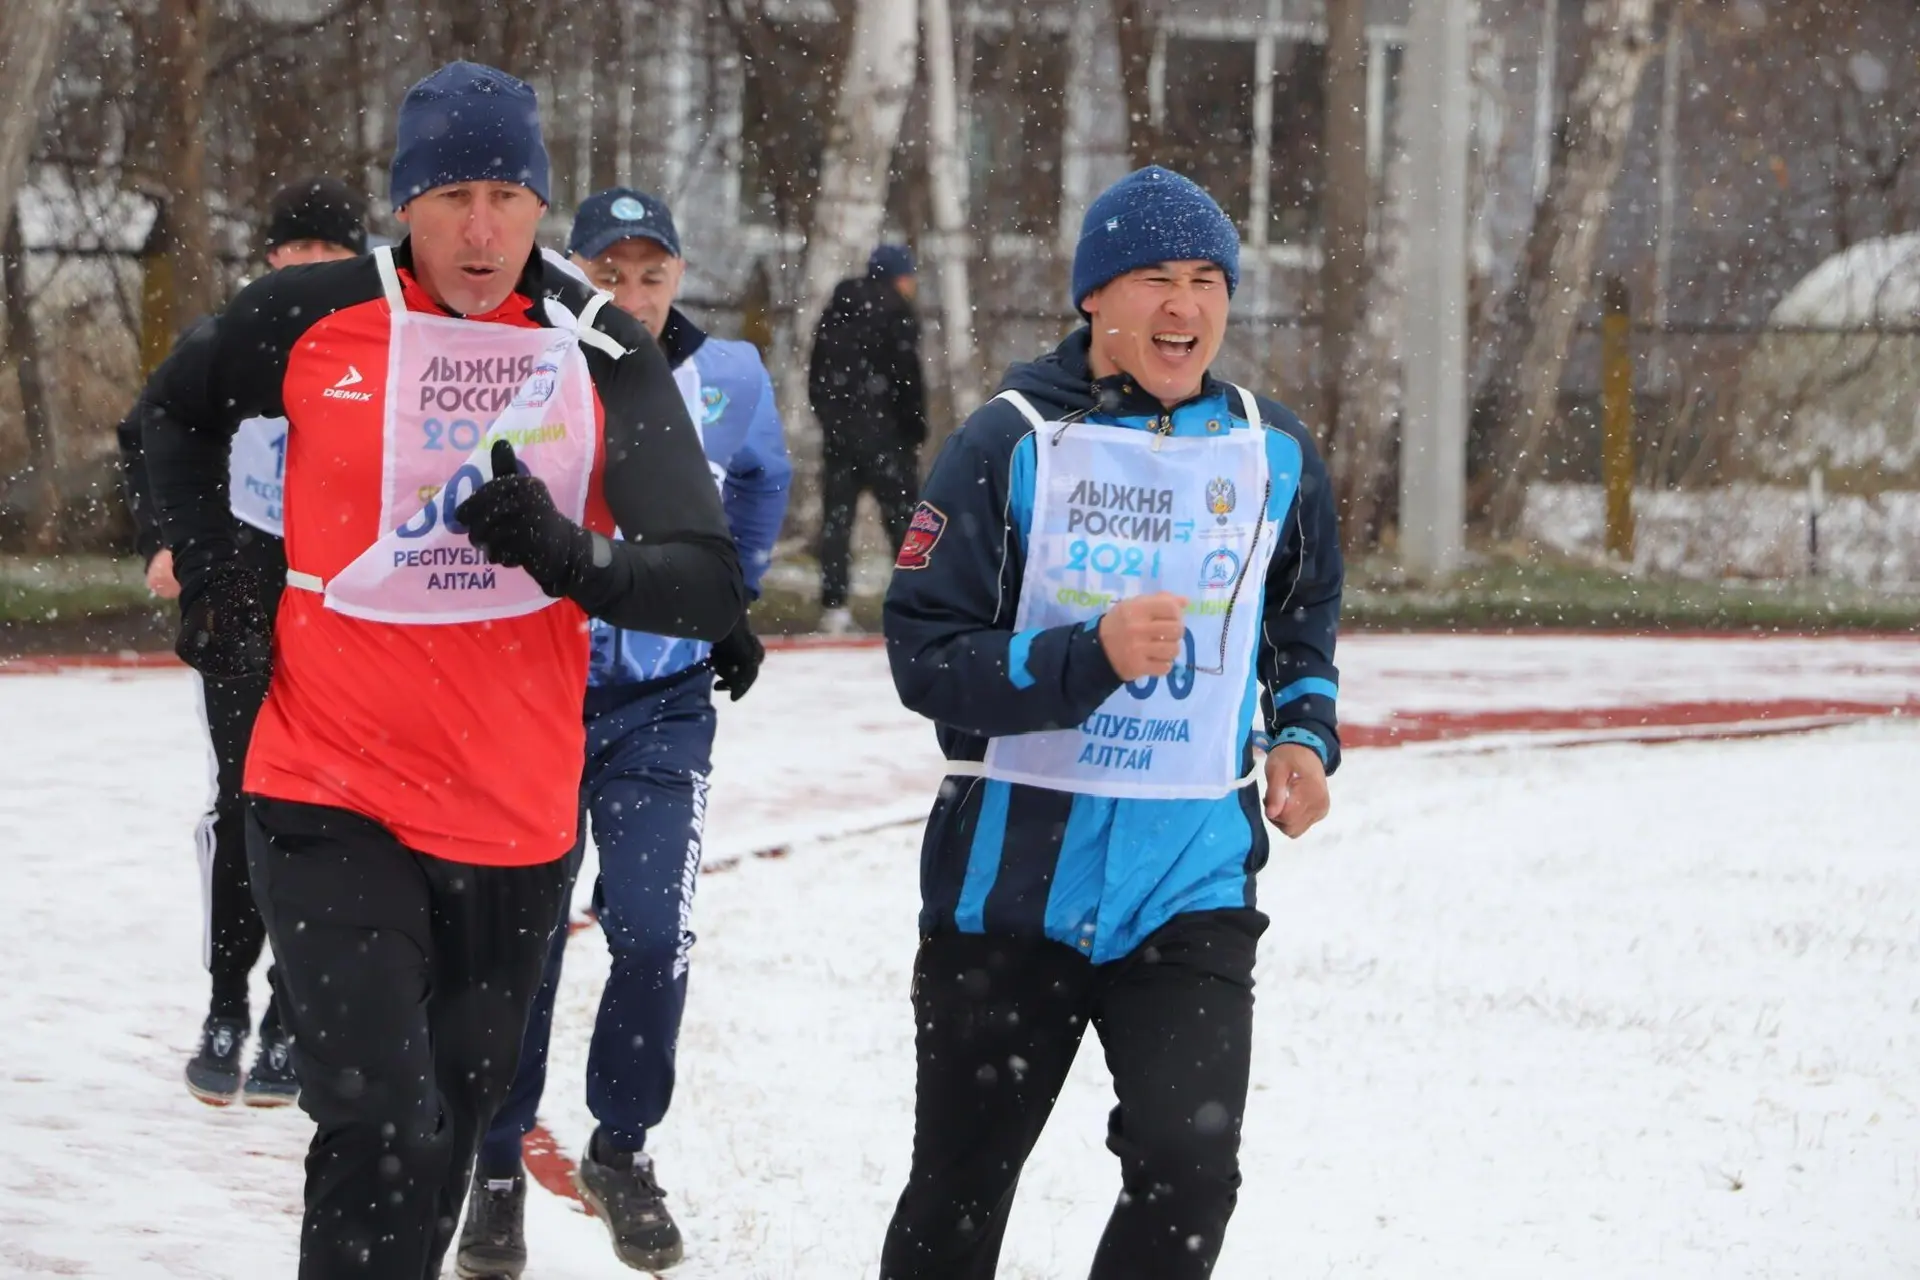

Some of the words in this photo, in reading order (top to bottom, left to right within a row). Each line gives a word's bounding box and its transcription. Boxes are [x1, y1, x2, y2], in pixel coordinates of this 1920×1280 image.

[419, 355, 534, 384] ЛЫЖНЯ
[323, 388, 374, 402] DEMIX
[1066, 480, 1173, 514] ЛЫЖНЯ
[1067, 508, 1171, 542] РОССИИ
[394, 547, 487, 567] РЕСПУБЛ
[1065, 539, 1160, 579] 2021
[427, 568, 496, 590] АЛТАЙ
[1082, 711, 1190, 742] СПУБЛИКА
[1078, 742, 1153, 771] АЛТАЙ
